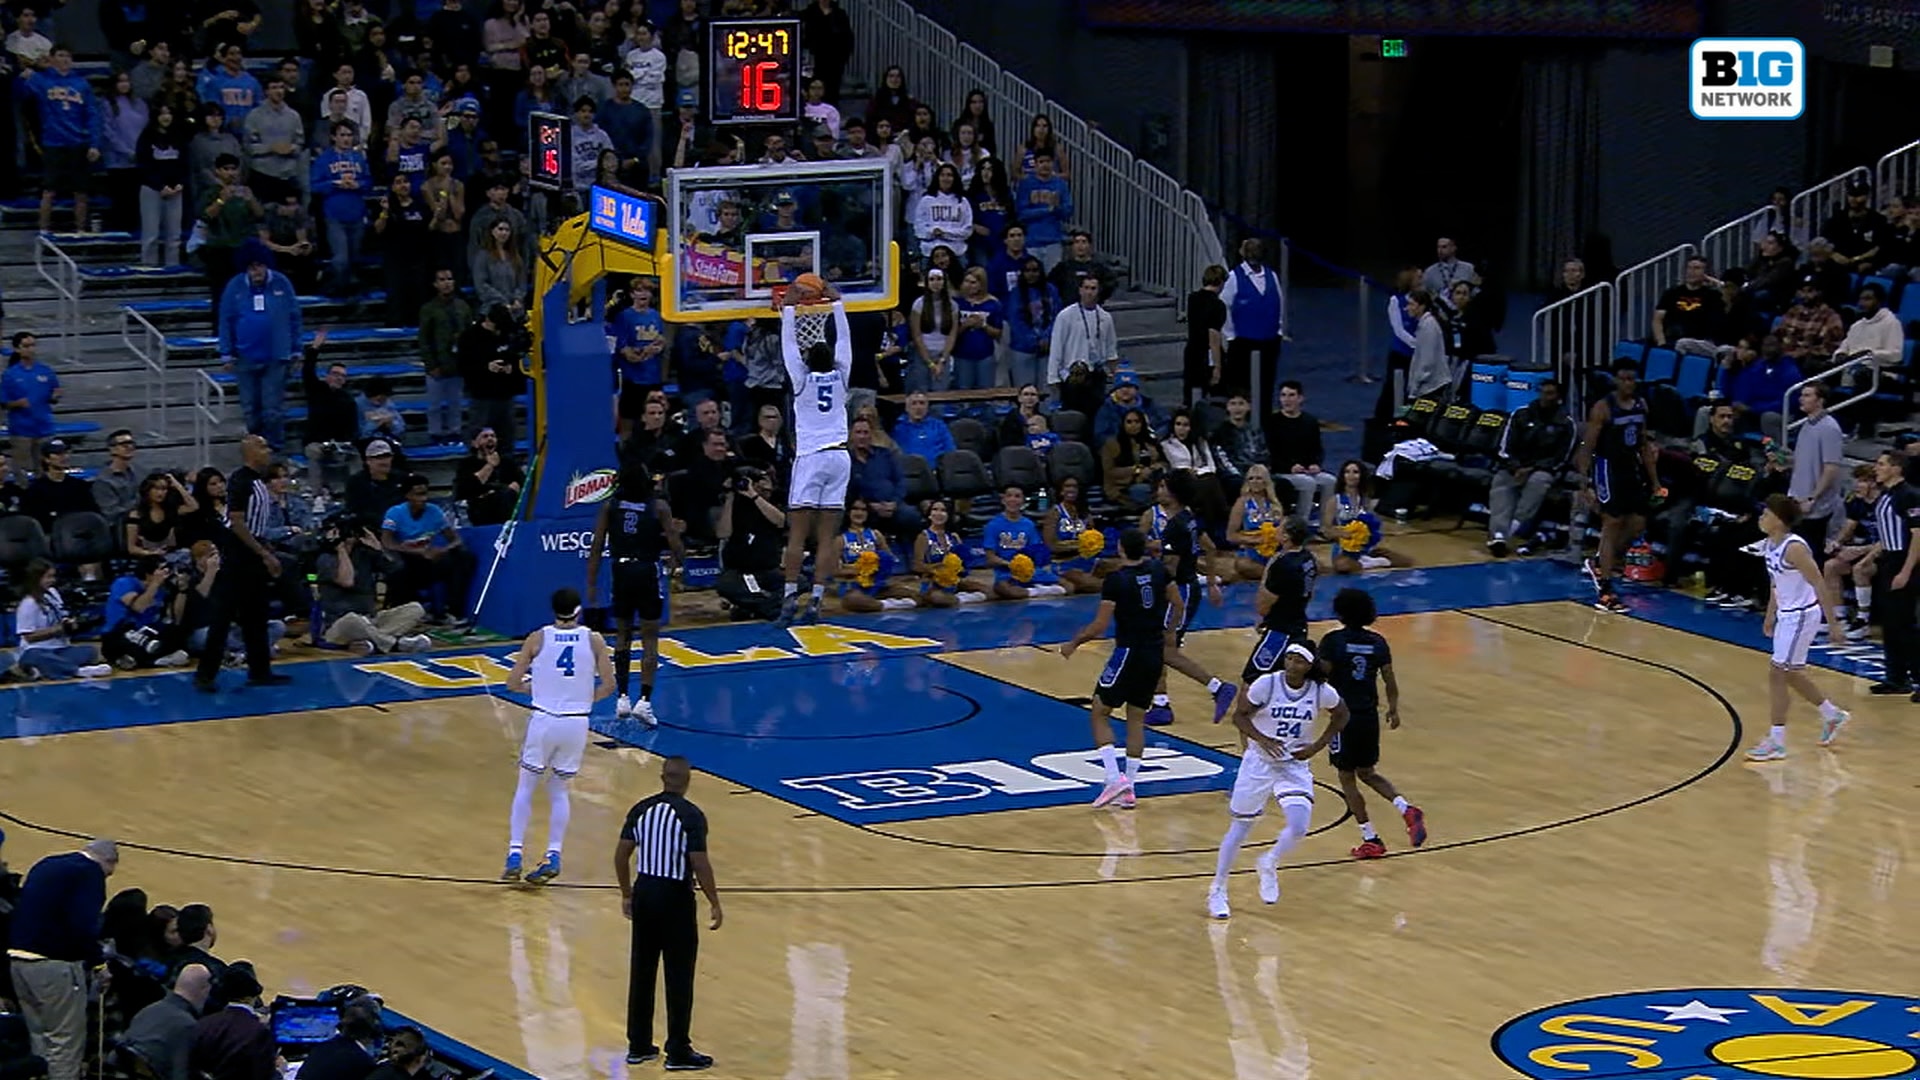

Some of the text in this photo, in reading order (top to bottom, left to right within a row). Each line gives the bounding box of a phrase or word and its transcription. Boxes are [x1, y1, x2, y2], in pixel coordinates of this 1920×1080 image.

[727, 30, 789, 59] 12:47
[742, 62, 782, 111] 16
[931, 205, 962, 223] UCLA
[694, 258, 721, 281] State
[817, 384, 833, 413] 5
[623, 510, 639, 535] 2
[1140, 584, 1154, 609] 0
[556, 645, 575, 677] 4
[1351, 654, 1367, 681] 3
[1271, 706, 1313, 721] UCLA
[1276, 720, 1302, 739] 24
[780, 745, 1224, 811] B1G
